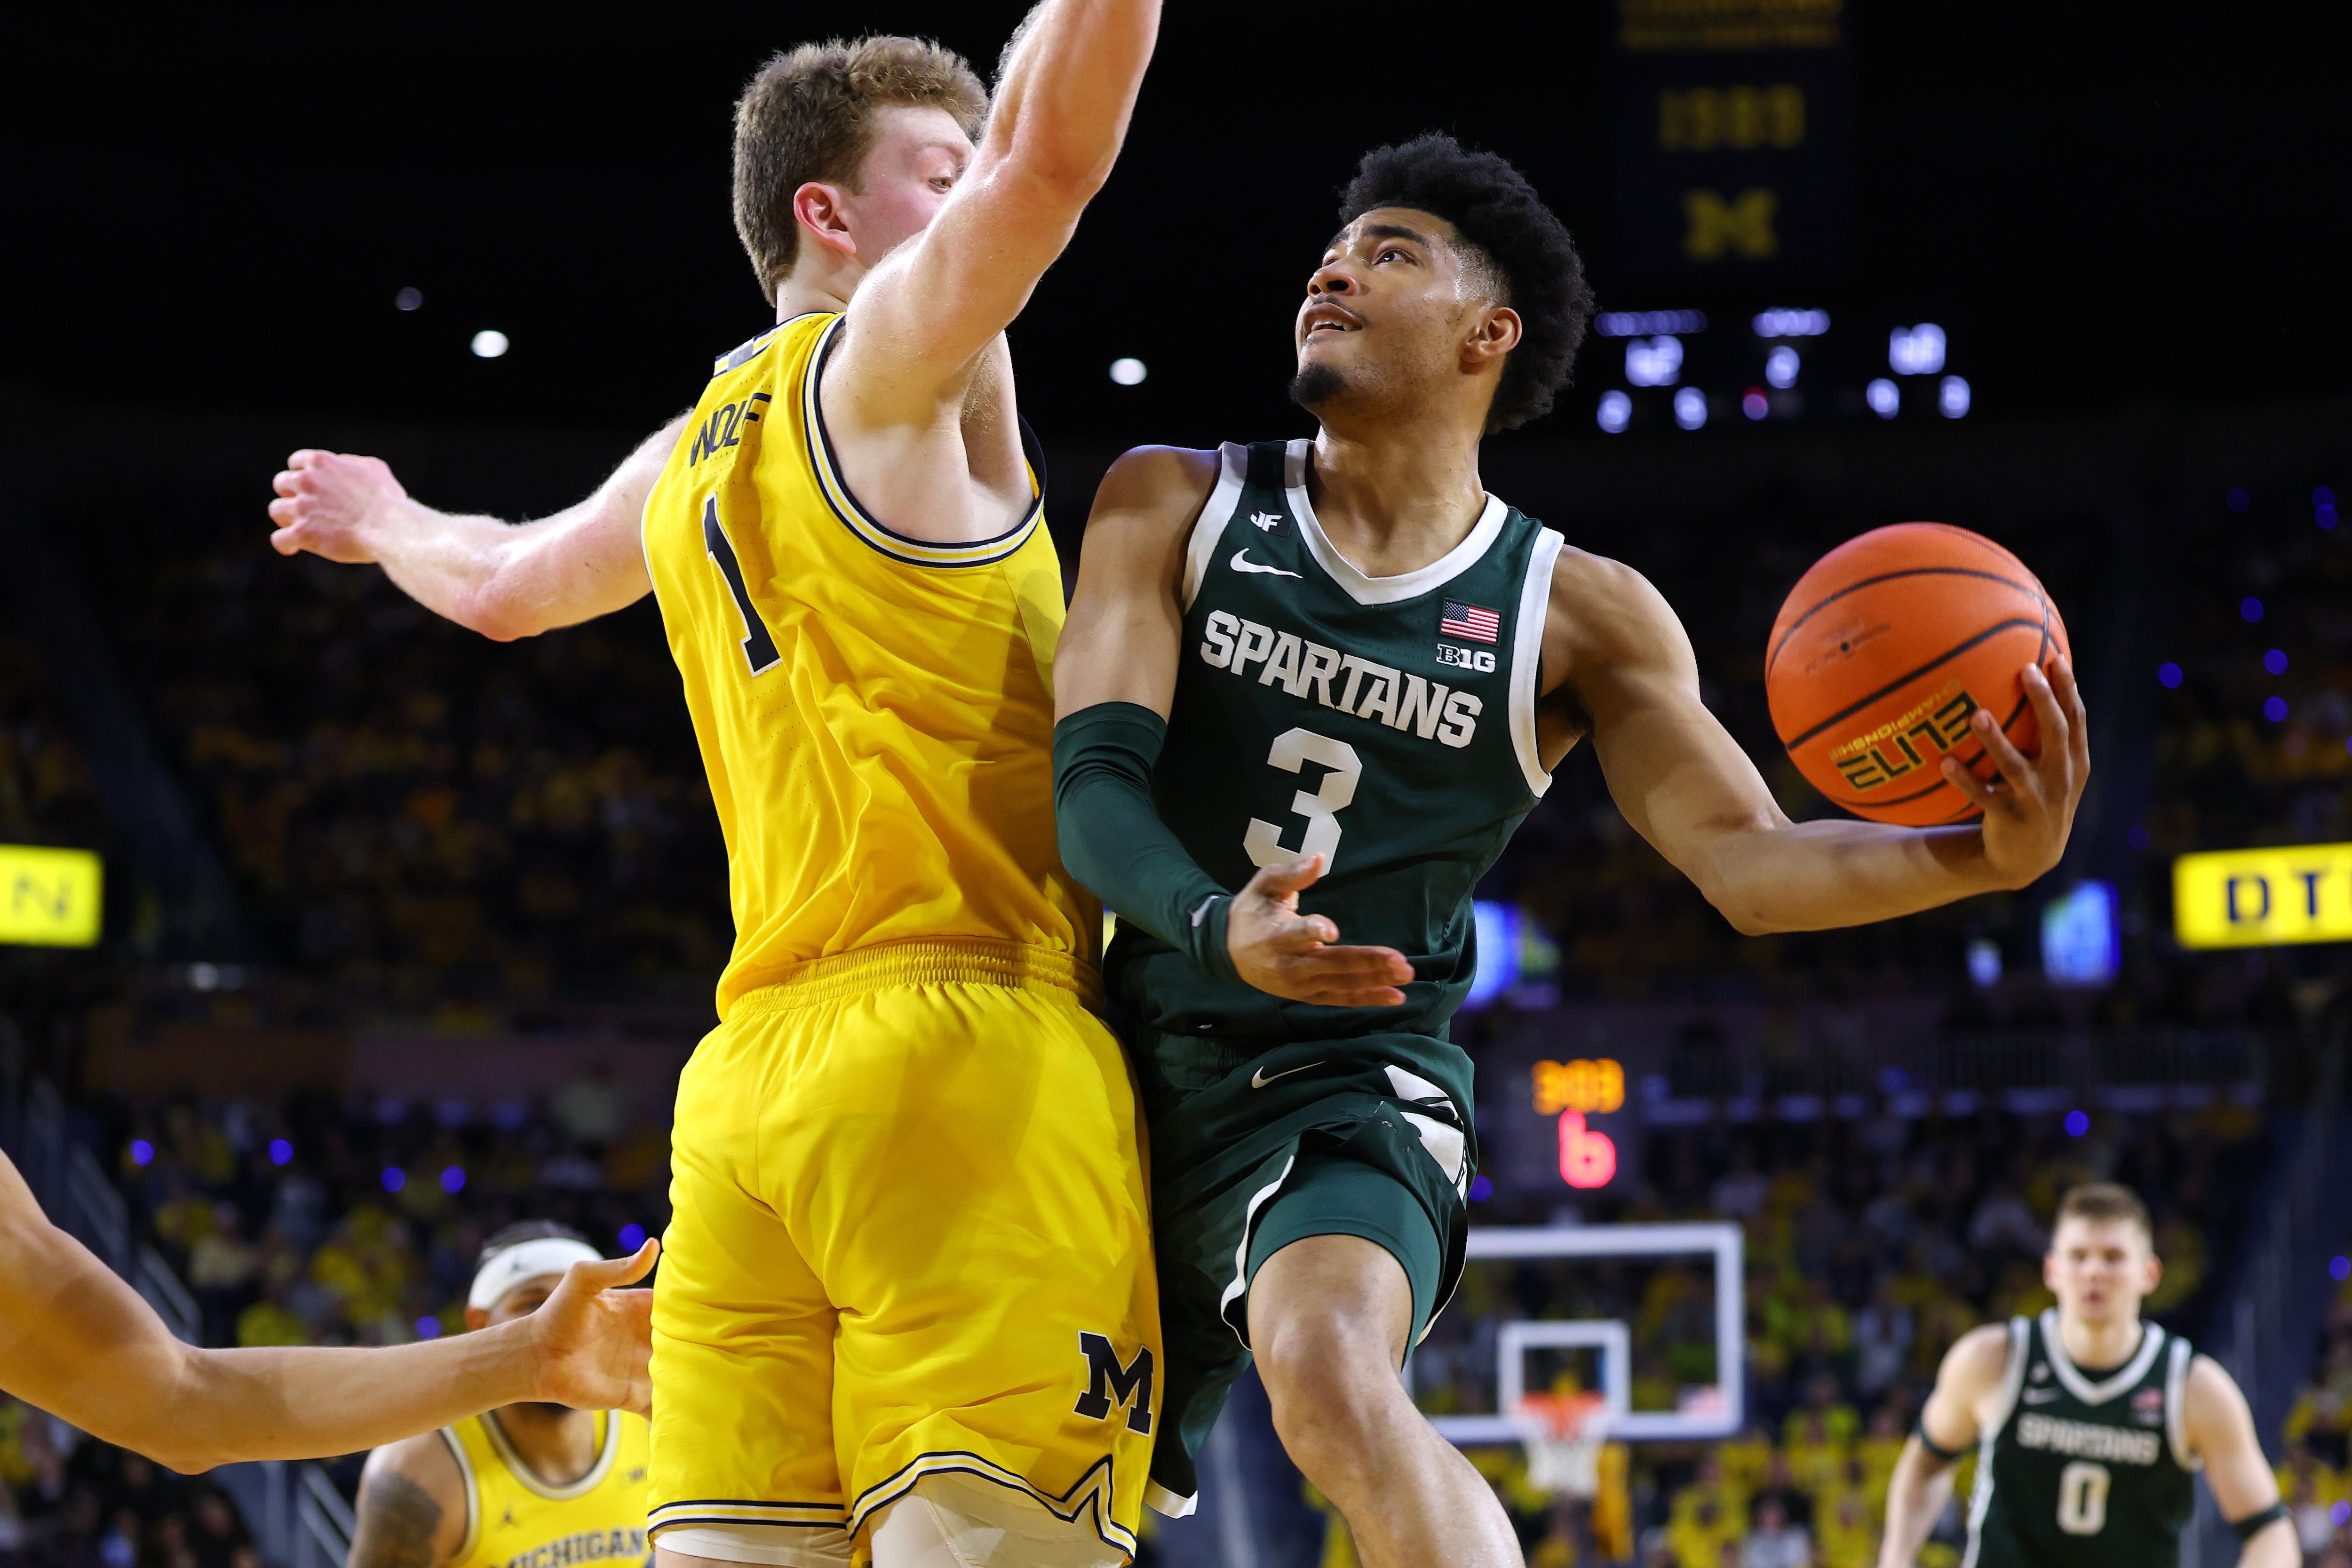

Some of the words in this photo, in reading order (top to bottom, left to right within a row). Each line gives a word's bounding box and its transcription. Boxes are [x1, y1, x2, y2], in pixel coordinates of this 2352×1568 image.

[690, 392, 771, 468] WOLF
[702, 491, 782, 677] 1
[1200, 610, 1483, 748] SPARTANS
[1835, 690, 1979, 791] ELITE
[1243, 727, 1363, 877] 3
[2226, 869, 2352, 923] DT
[1558, 1108, 1616, 1189] 6
[1072, 1329, 1154, 1437] M
[2016, 1411, 2160, 1466] SPARTANS
[2056, 1461, 2111, 1536] 0
[488, 1526, 645, 1568] ICHIGAN
